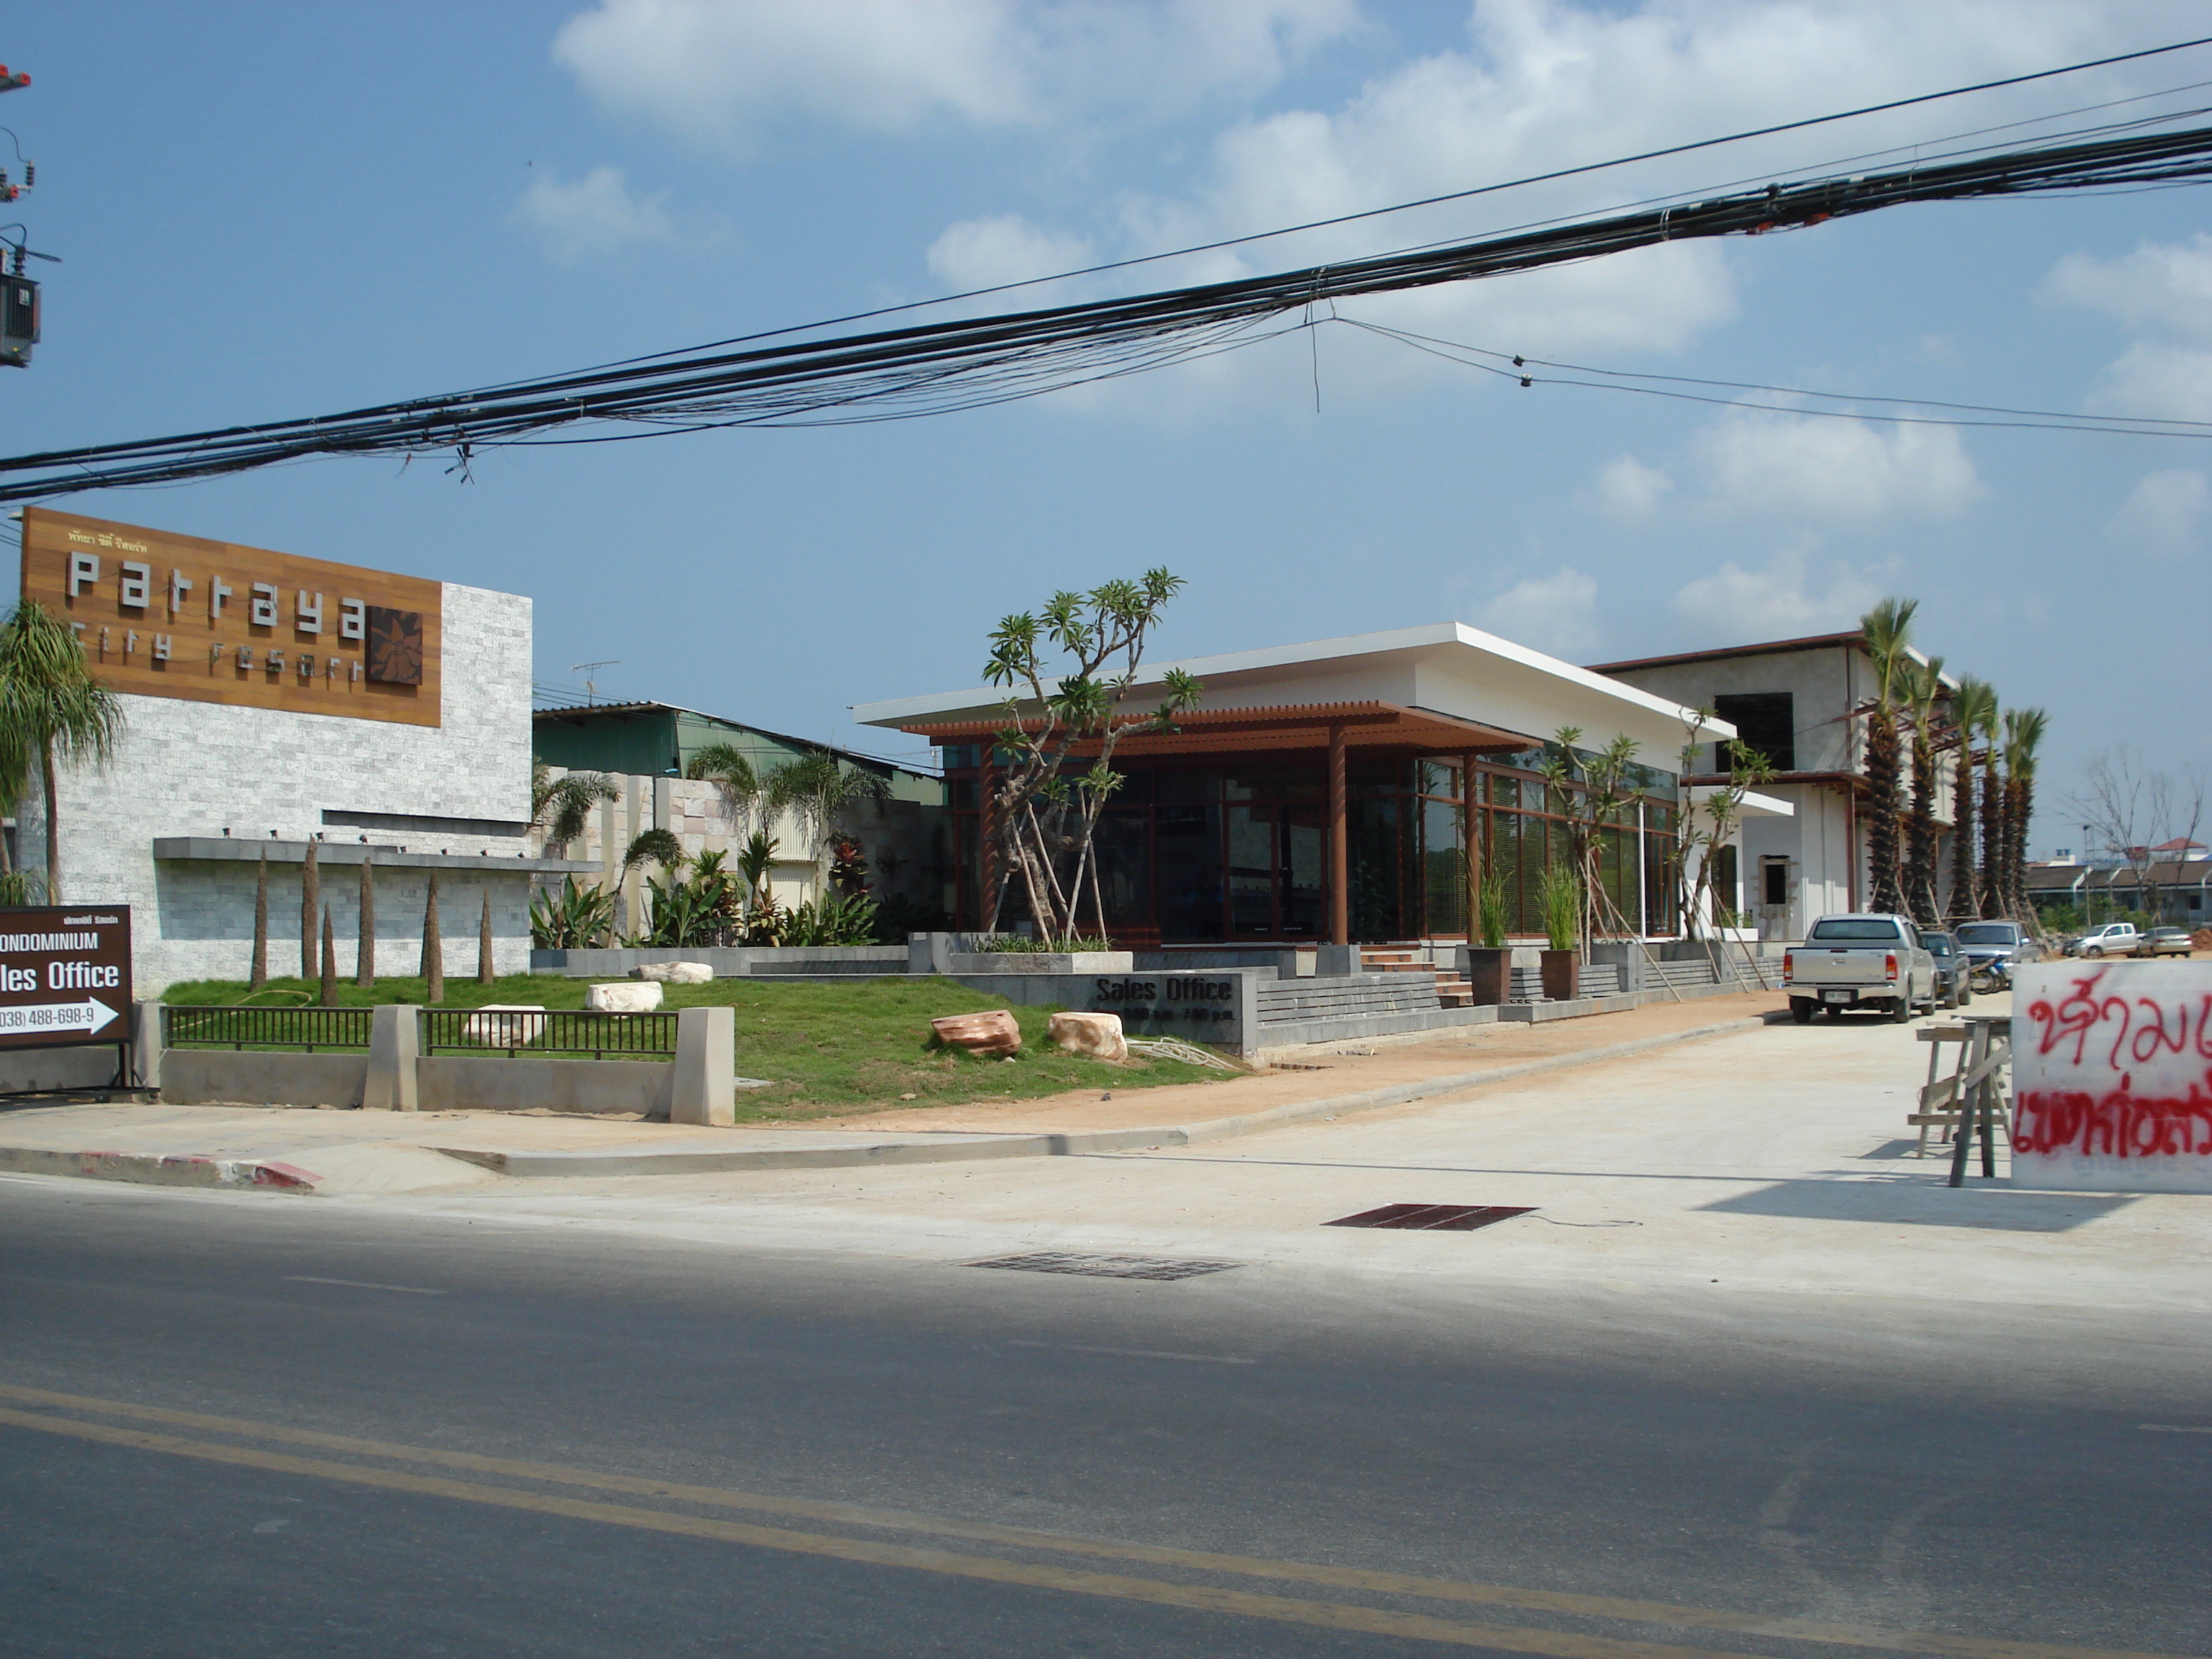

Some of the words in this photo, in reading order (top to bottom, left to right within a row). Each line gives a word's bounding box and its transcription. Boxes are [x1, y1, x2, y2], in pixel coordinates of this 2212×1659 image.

[48, 961, 120, 990] Office
[1097, 978, 1156, 1001] Sales
[1166, 977, 1232, 1001] Office
[29, 1007, 94, 1026] 488-698-9
